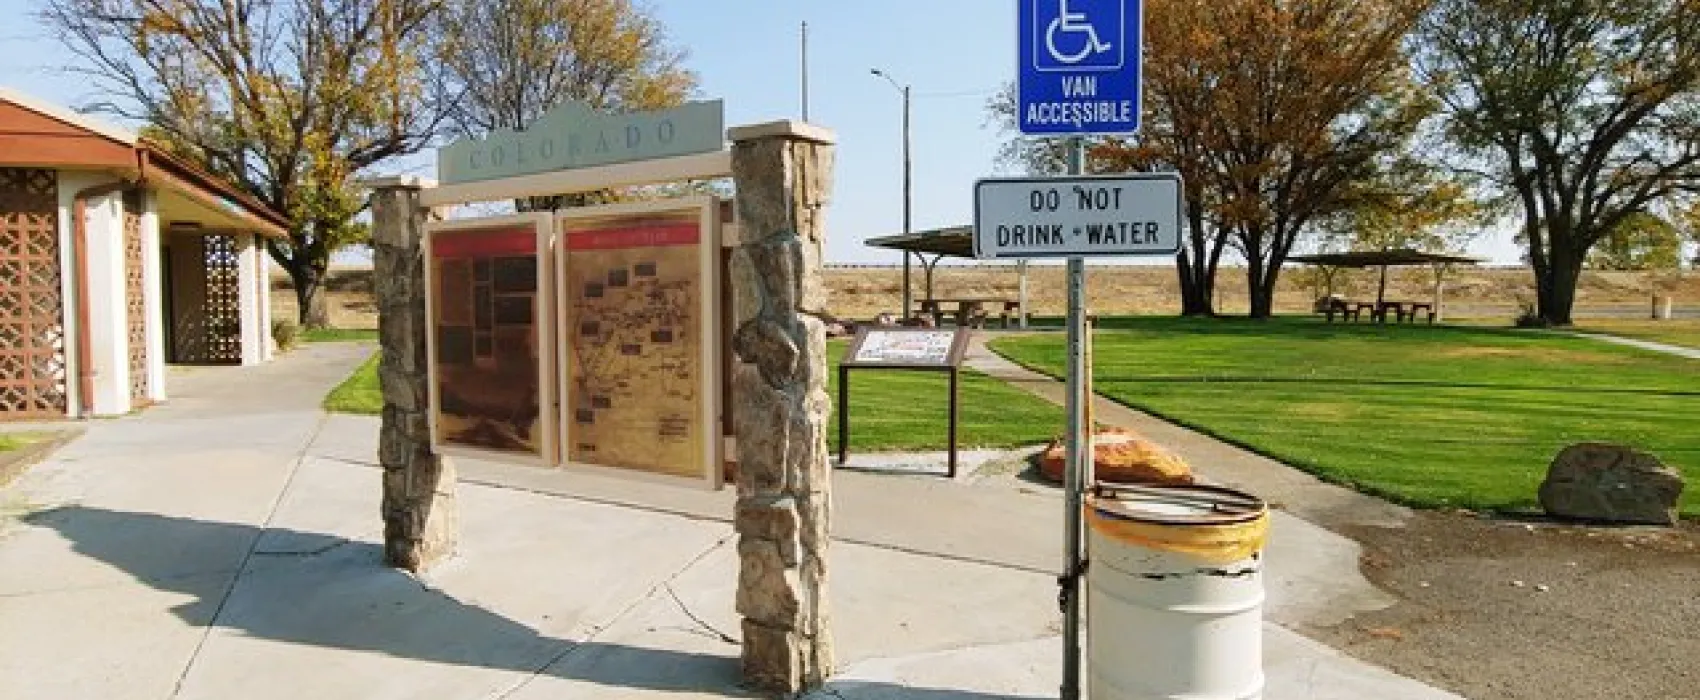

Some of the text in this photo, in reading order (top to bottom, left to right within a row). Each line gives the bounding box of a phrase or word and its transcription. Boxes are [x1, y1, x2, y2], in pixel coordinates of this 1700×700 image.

[1062, 76, 1097, 98] VAN
[1027, 101, 1132, 124] ACCESSIBLE
[469, 120, 675, 170] COLORADO
[1030, 187, 1124, 212] DO NOT
[997, 222, 1159, 247] DRINK WATER
